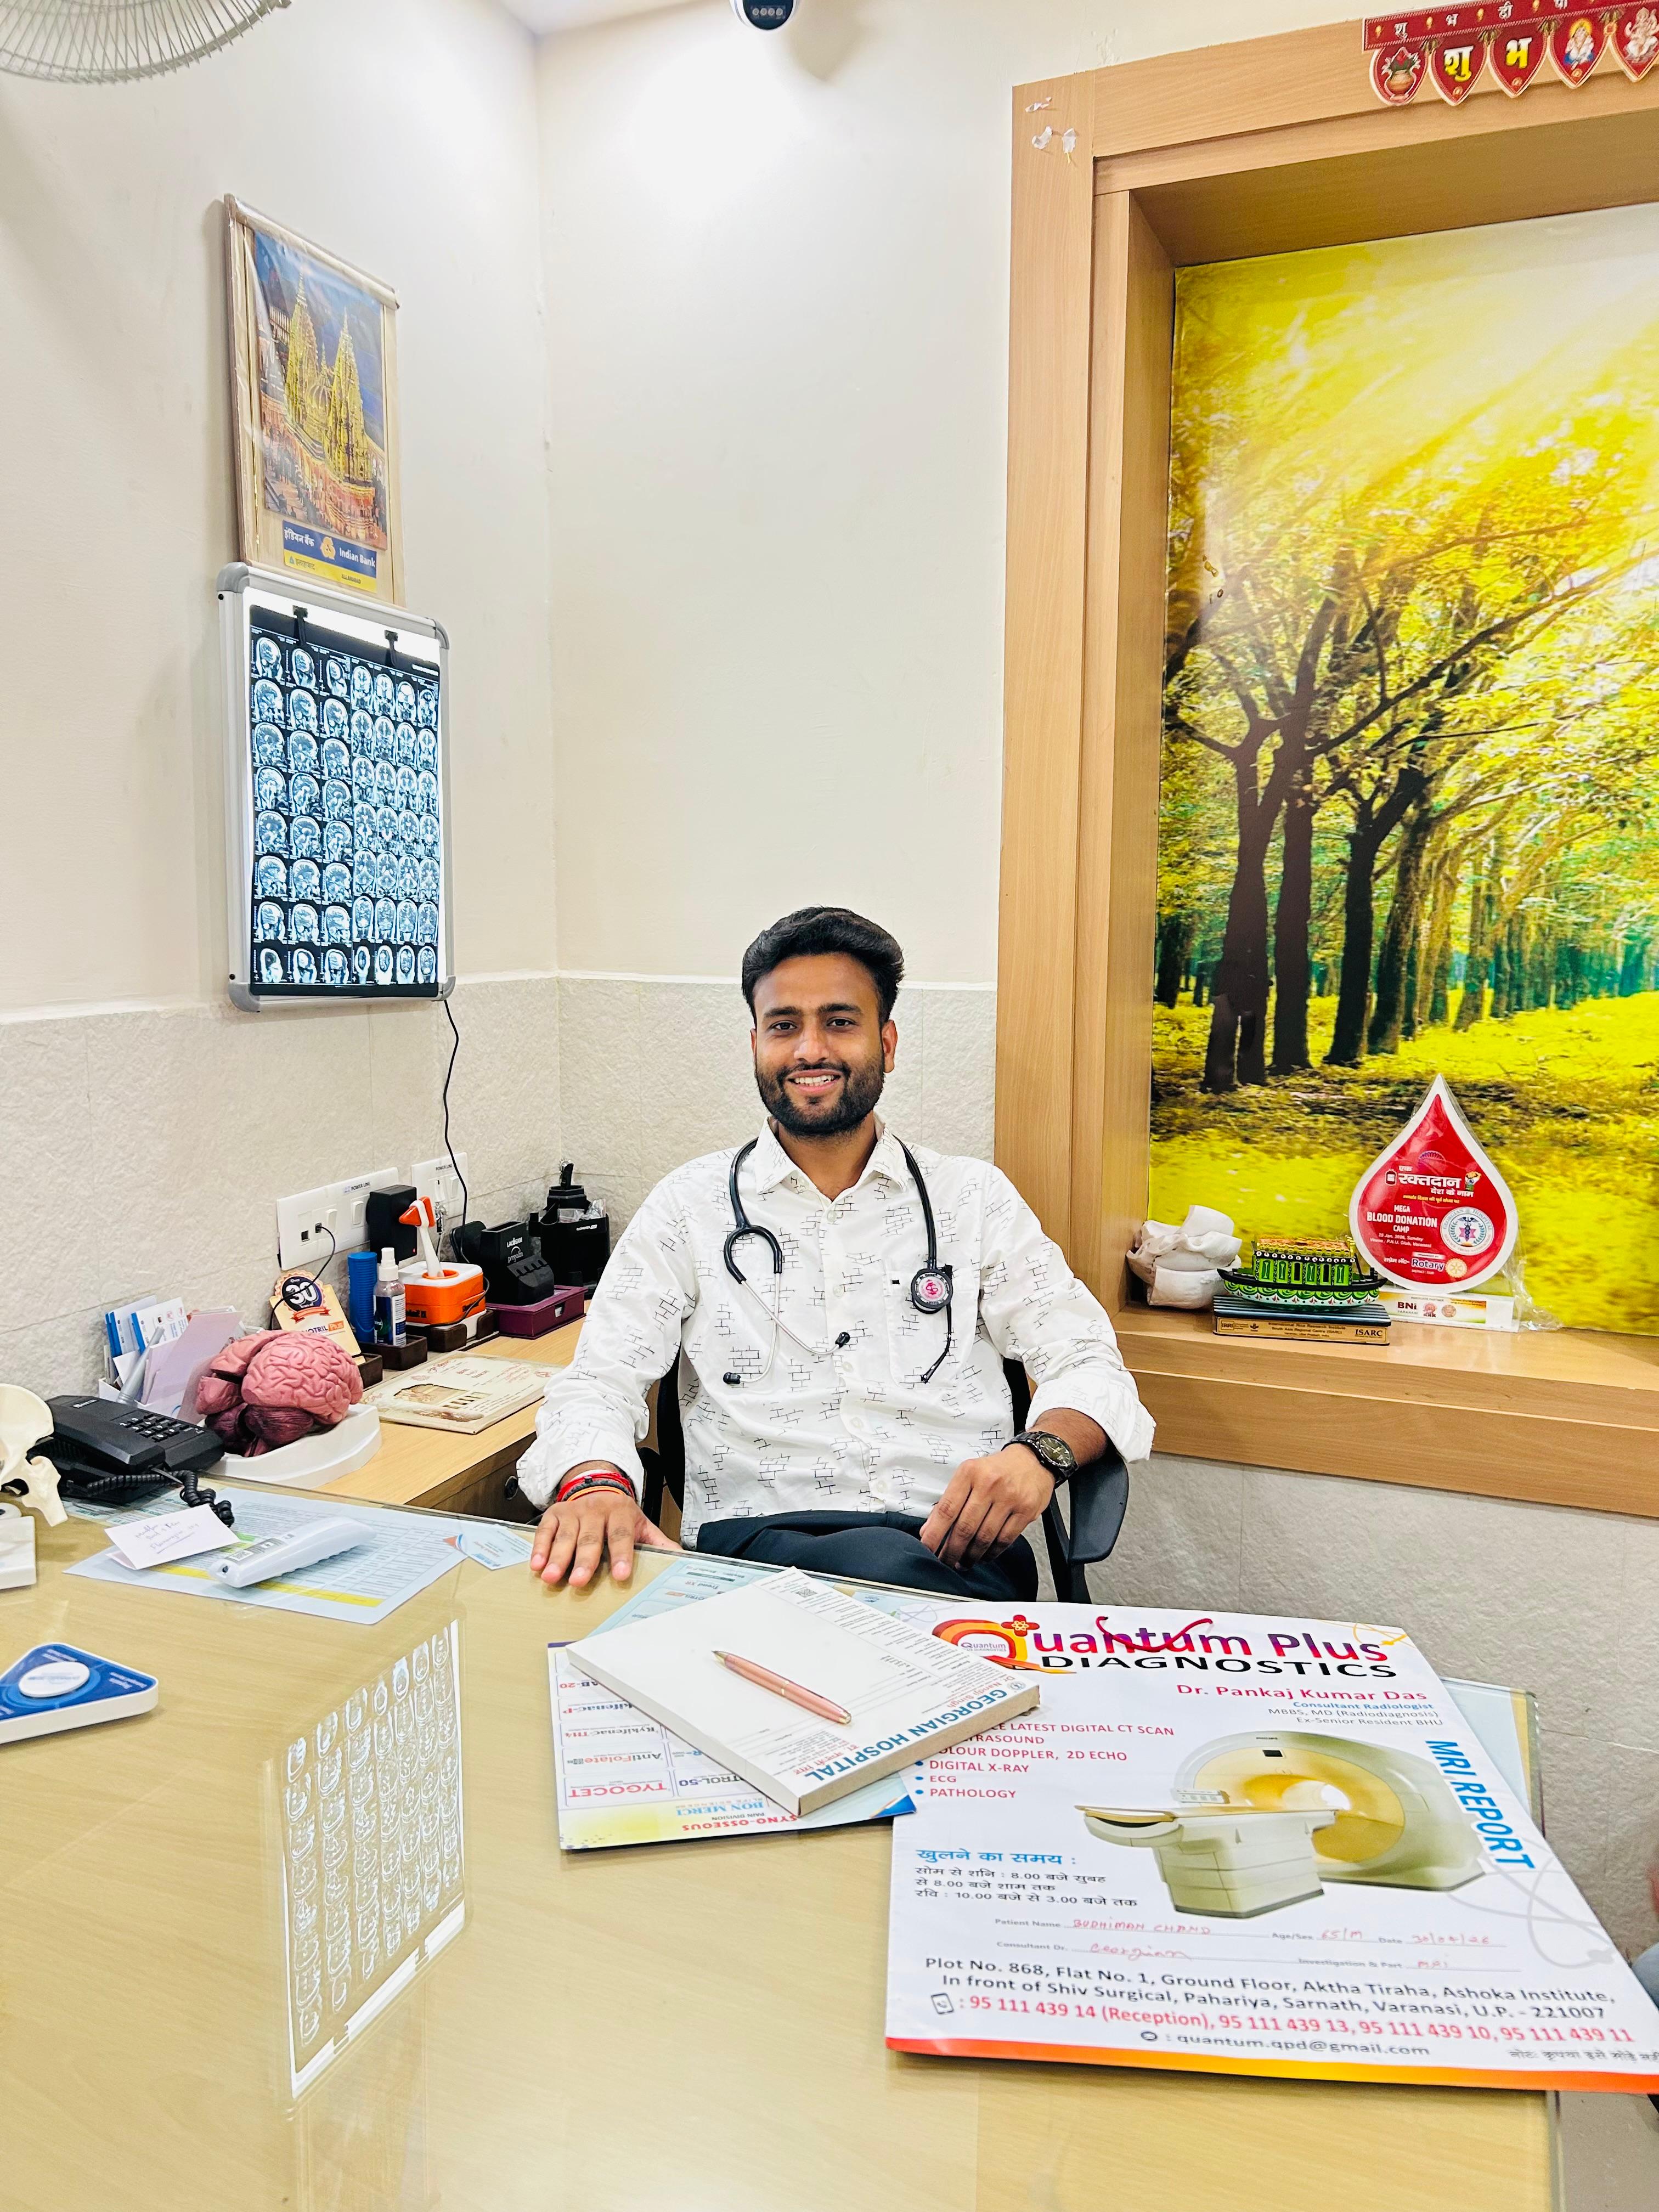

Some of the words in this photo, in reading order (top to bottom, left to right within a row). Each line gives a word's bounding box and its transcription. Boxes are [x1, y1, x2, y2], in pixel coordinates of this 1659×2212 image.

[339, 547, 359, 562] Indian
[359, 554, 376, 568] Bank
[1398, 1172, 1462, 1189] रक्तदान
[1393, 1205, 1410, 1213] MEGA
[1367, 1212, 1393, 1223] BLOOD
[1395, 1215, 1438, 1228] DONATION
[1393, 1224, 1409, 1233] CAMP
[1412, 1257, 1444, 1272] Rotary
[285, 1282, 318, 1305] 30
[329, 1323, 344, 1331] Plus
[1355, 1328, 1383, 1336] ISARC
[961, 1642, 1007, 1650] Quantum
[1266, 1631, 1389, 1663] Plus
[1042, 1655, 1397, 1678] DIAGNOSTICS
[1176, 1684, 1209, 1696] Dr.
[1216, 1685, 1294, 1700] Pankaj
[1299, 1688, 1375, 1701] Kumar
[1383, 1691, 1427, 1701] Das
[946, 1695, 974, 1709] Singh
[1293, 1701, 1361, 1710] Consultant
[1363, 1702, 1435, 1711] Radiologist
[907, 1689, 1008, 1739] GEORGIAN
[1267, 1708, 1308, 1717] MBBS,
[1336, 1710, 1439, 1718] (Radiodiagnosis)
[1011, 1723, 1056, 1733] LATEST
[1061, 1724, 1114, 1733] DIGITAL
[1118, 1725, 1133, 1734] CT
[1137, 1726, 1175, 1736] SCAN
[804, 1733, 911, 1781] HOSPITAL
[991, 1748, 1059, 1760] DOPPLER,
[1066, 1751, 1085, 1760] 2D
[1089, 1751, 1127, 1762] ECHO
[1425, 1740, 1477, 1776] MRI
[929, 1760, 985, 1772] DIGITAL
[988, 1762, 1029, 1773] X-RAY
[930, 1775, 957, 1783] ECG
[568, 1782, 667, 1798] TYGOCET
[929, 1788, 1016, 1799] PATHOLOGY
[676, 1804, 726, 1816] MERCI
[731, 1801, 764, 1809] BON
[681, 1814, 797, 1831] SYNO-OSSEOUS
[1449, 1781, 1536, 1870] REPORT
[916, 1848, 971, 1863] खुलने
[977, 1851, 1003, 1863] का
[1010, 1853, 1063, 1865] समय
[915, 1866, 945, 1876] सोम
[949, 1867, 963, 1876] से
[967, 1868, 996, 1878] शनि
[1011, 1872, 1041, 1881] 8.00
[1045, 1871, 1069, 1882] बजे
[915, 1876, 929, 1887] से
[933, 1880, 963, 1888] 8.00
[967, 1880, 992, 1891] बजे
[997, 1882, 1026, 1891] शाम
[1031, 1883, 1056, 1892] तक
[956, 1891, 992, 1900] 10.00
[996, 1892, 1022, 1902] बजे
[1026, 1892, 1041, 1903] से
[1046, 1895, 1078, 1905] 3.00
[1082, 1896, 1108, 1906] बजे
[1113, 1898, 1138, 1907] तक
[995, 1918, 1030, 1927] Patient
[1271, 1932, 1314, 1942] Age/Sex
[1378, 1937, 1403, 1945] Date
[996, 1941, 1050, 1950] Consultant
[1298, 1958, 1365, 1968] Investigation
[925, 1957, 963, 1970] Plot
[969, 1960, 1003, 1973] No.
[1009, 1962, 1050, 1978] 868,
[1056, 1966, 1093, 1979] Flat
[1098, 1970, 1132, 1983] No.
[1139, 1972, 1155, 1985] 1,
[1161, 1974, 1235, 1989] Ground
[1240, 1978, 1297, 1993] Floor,
[1304, 1980, 1361, 1995] Aktha
[1368, 1983, 1437, 1999] Tiraha,
[1443, 1987, 1516, 2001] Ashoka
[1520, 1989, 1616, 2004] Institute,
[943, 1974, 961, 1986] In
[966, 1976, 1014, 1990] front
[1022, 1980, 1043, 1993] of
[1048, 1983, 1088, 1996] Shiv
[1094, 1987, 1178, 2005] Surgical,
[1183, 1991, 1278, 2011] Pahariya,
[1283, 1997, 1369, 2013] Sarnath,
[1373, 2000, 1469, 2018] Varanasi,
[1472, 2004, 1515, 2019] U.P.
[1532, 2006, 1605, 2020] 221007
[969, 1995, 992, 2010] 95
[997, 1997, 1031, 2013] 111
[1035, 2001, 1069, 2017] 439
[1074, 2004, 1096, 2019] 14
[1101, 2005, 1216, 2030] (Reception),
[1218, 2015, 1243, 2029] 95
[1247, 2016, 1282, 2032] 111
[1286, 2018, 1321, 2032] 439
[1325, 2019, 1356, 2035] 13,
[1359, 2021, 1383, 2035] 95
[1387, 2022, 1424, 2037] 111
[1427, 2023, 1462, 2039] 439
[1465, 2025, 1499, 2042] 10,
[1500, 2027, 1526, 2041] 95
[1530, 2028, 1566, 2042] 111
[1569, 2028, 1606, 2042] 439
[1609, 2029, 1635, 2043] 11
[1177, 2034, 1430, 2056] quantum.qpd@gmail.com
